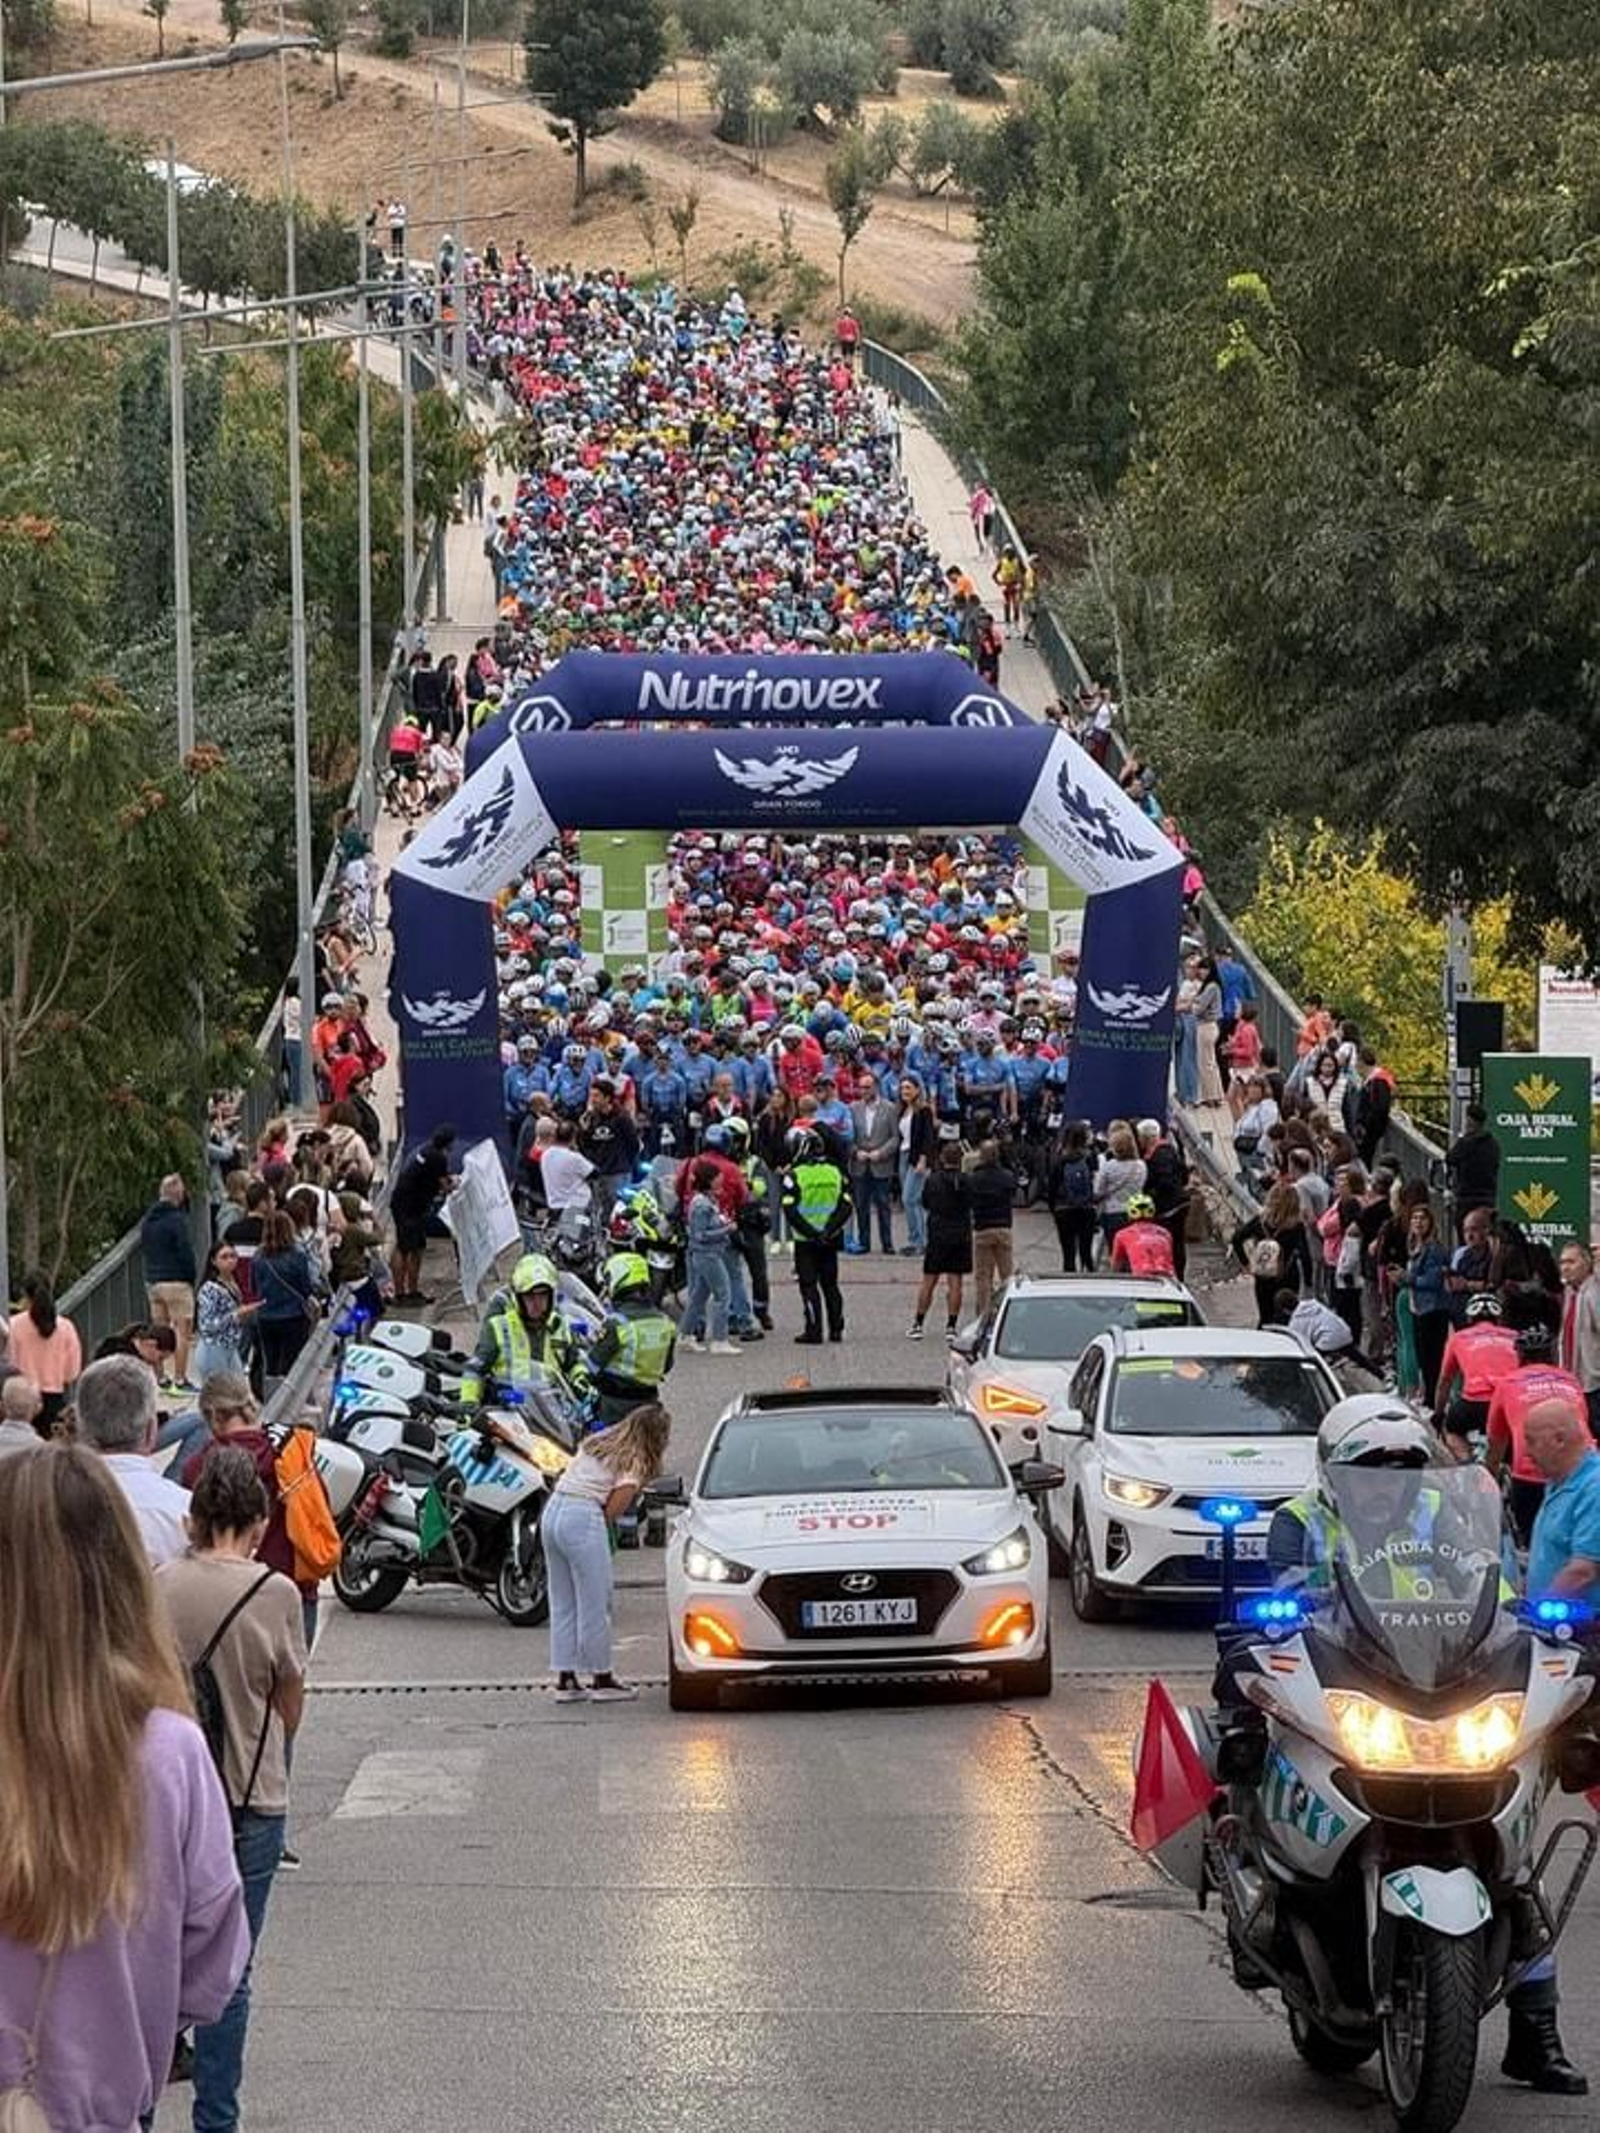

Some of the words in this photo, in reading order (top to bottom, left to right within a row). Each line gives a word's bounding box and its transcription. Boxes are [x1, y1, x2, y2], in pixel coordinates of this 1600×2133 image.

[638, 669, 882, 711] Nutrinovex
[1532, 1114, 1578, 1127] RURAL
[798, 1514, 898, 1530] STOP
[1350, 1541, 1433, 1579] GUARDIA
[820, 1604, 866, 1623] 1261
[875, 1602, 914, 1621] KYJ
